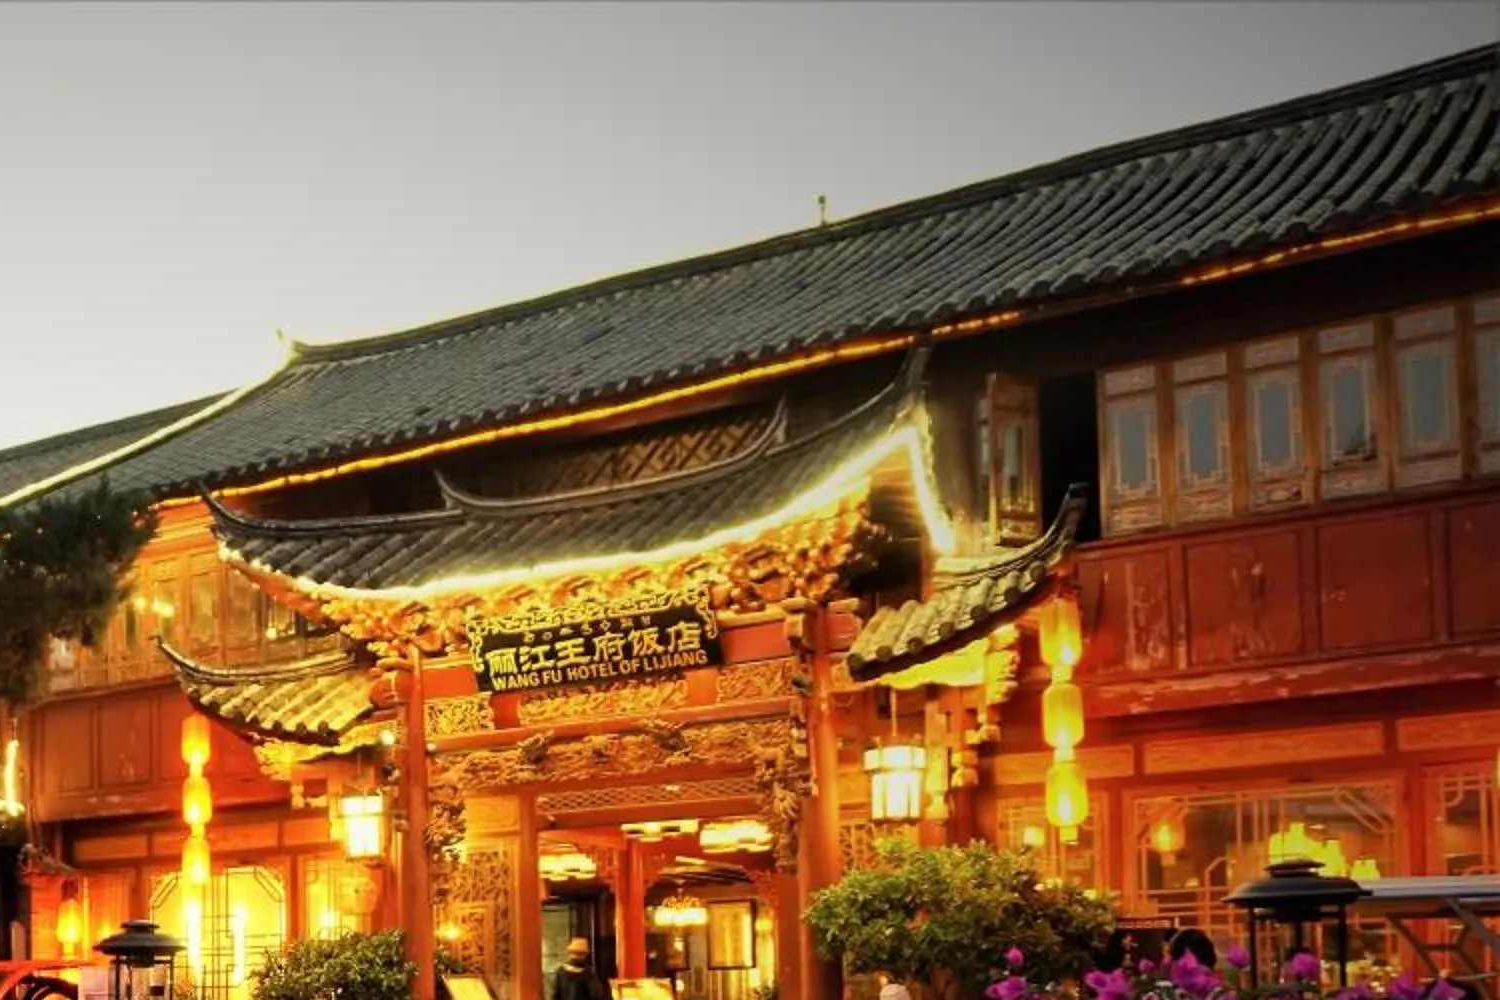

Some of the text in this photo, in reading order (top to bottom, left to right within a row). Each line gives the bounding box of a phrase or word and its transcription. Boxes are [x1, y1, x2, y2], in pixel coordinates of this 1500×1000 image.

[486, 621, 702, 677] 丽江王府饭店
[492, 649, 708, 690] WANG FU HOTEL OF LIJIANG
